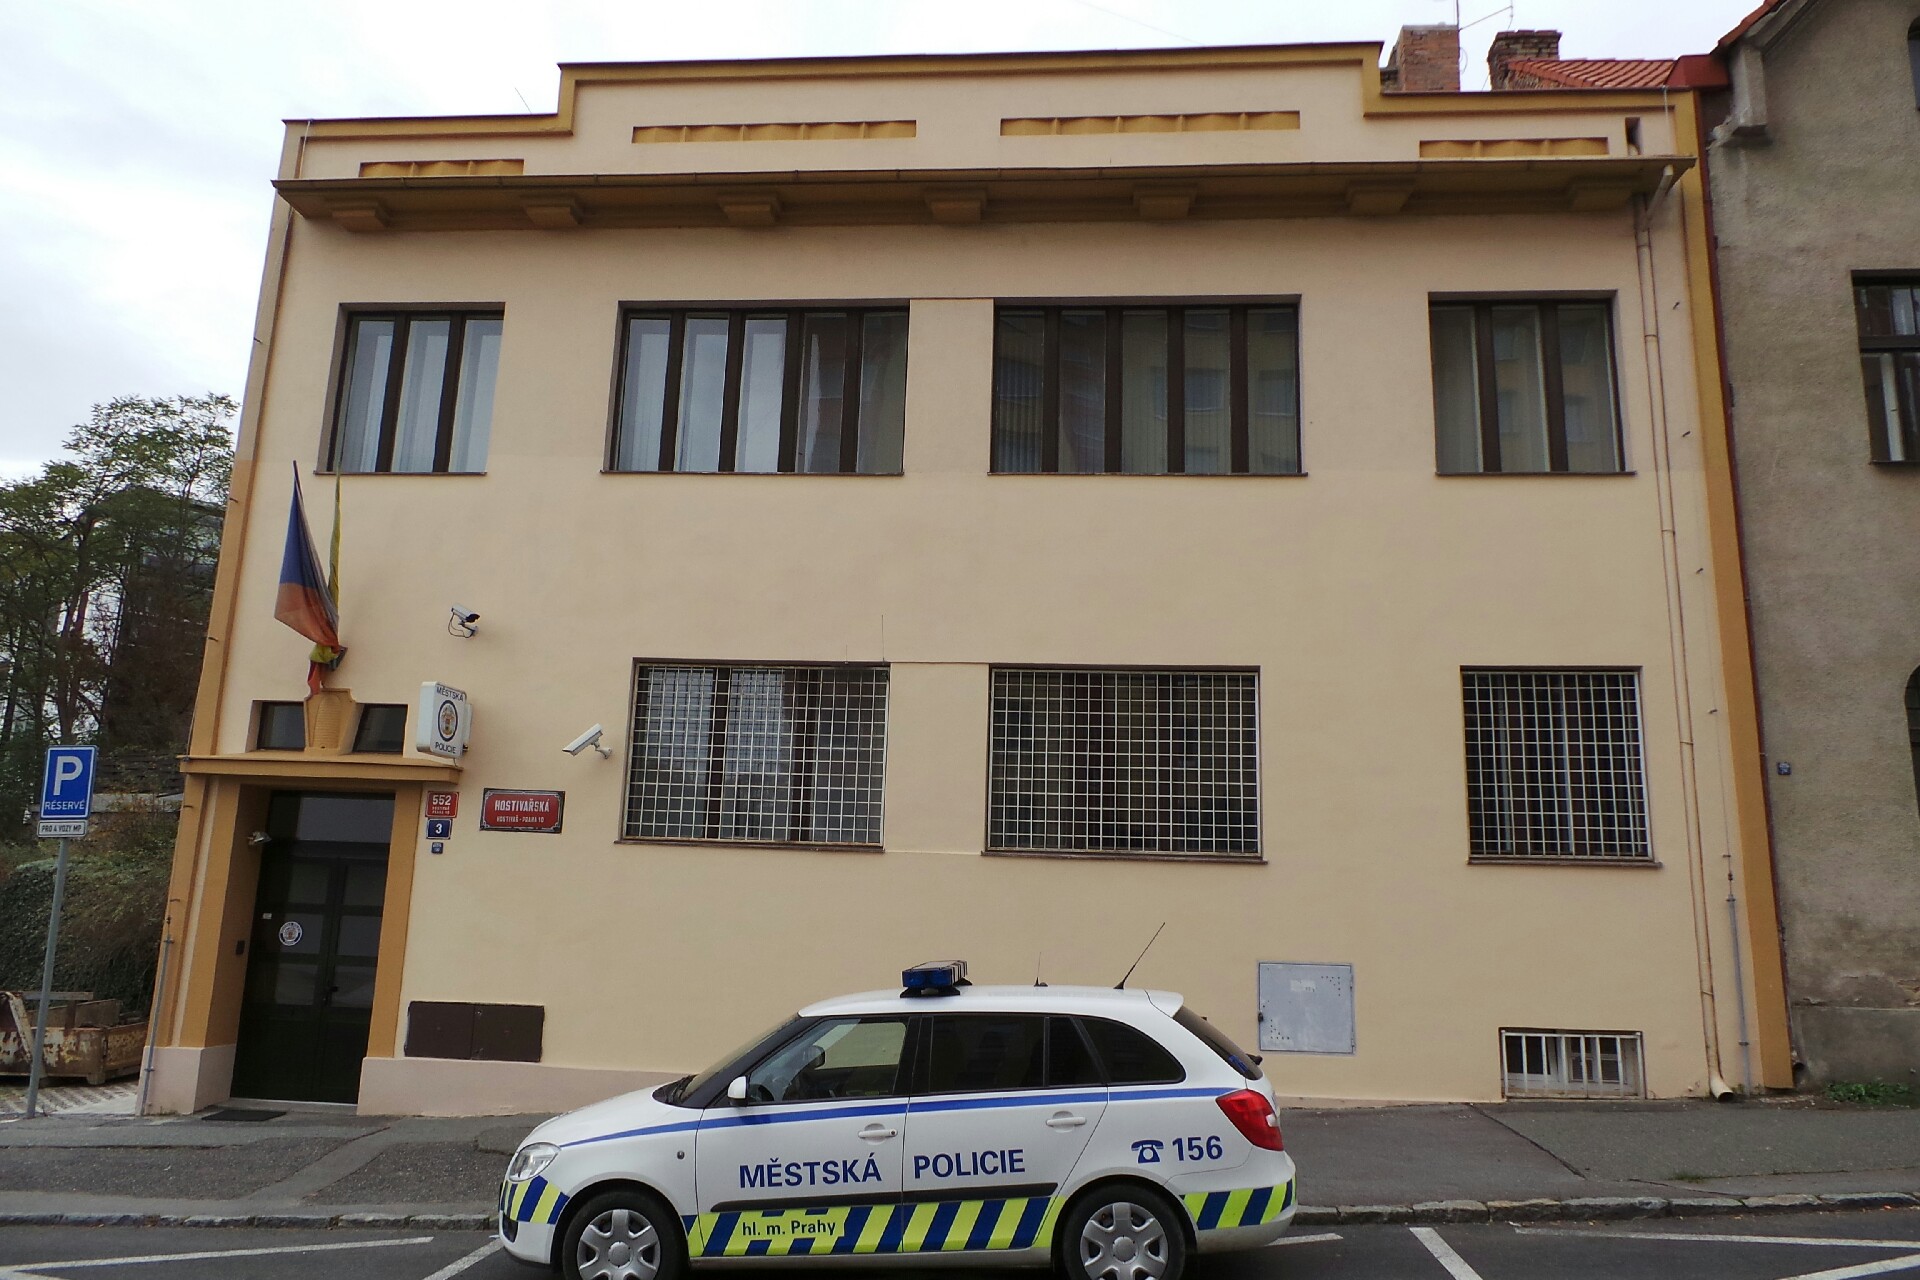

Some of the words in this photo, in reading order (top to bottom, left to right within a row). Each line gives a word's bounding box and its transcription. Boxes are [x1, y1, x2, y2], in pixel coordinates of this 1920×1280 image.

[435, 741, 457, 754] POLICIE
[53, 755, 83, 796] P
[45, 800, 85, 810] RÉSERVÉ
[432, 795, 452, 805] 552
[494, 798, 550, 812] HOSTIVAŘSKÁ
[435, 823, 443, 834] 3
[1172, 1135, 1223, 1161] 156
[739, 1152, 882, 1188] MĚSTSKÁ
[913, 1149, 1026, 1179] POLICIE
[742, 1222, 761, 1236] hl.
[766, 1224, 786, 1235] m.
[791, 1220, 836, 1236] Prahy
